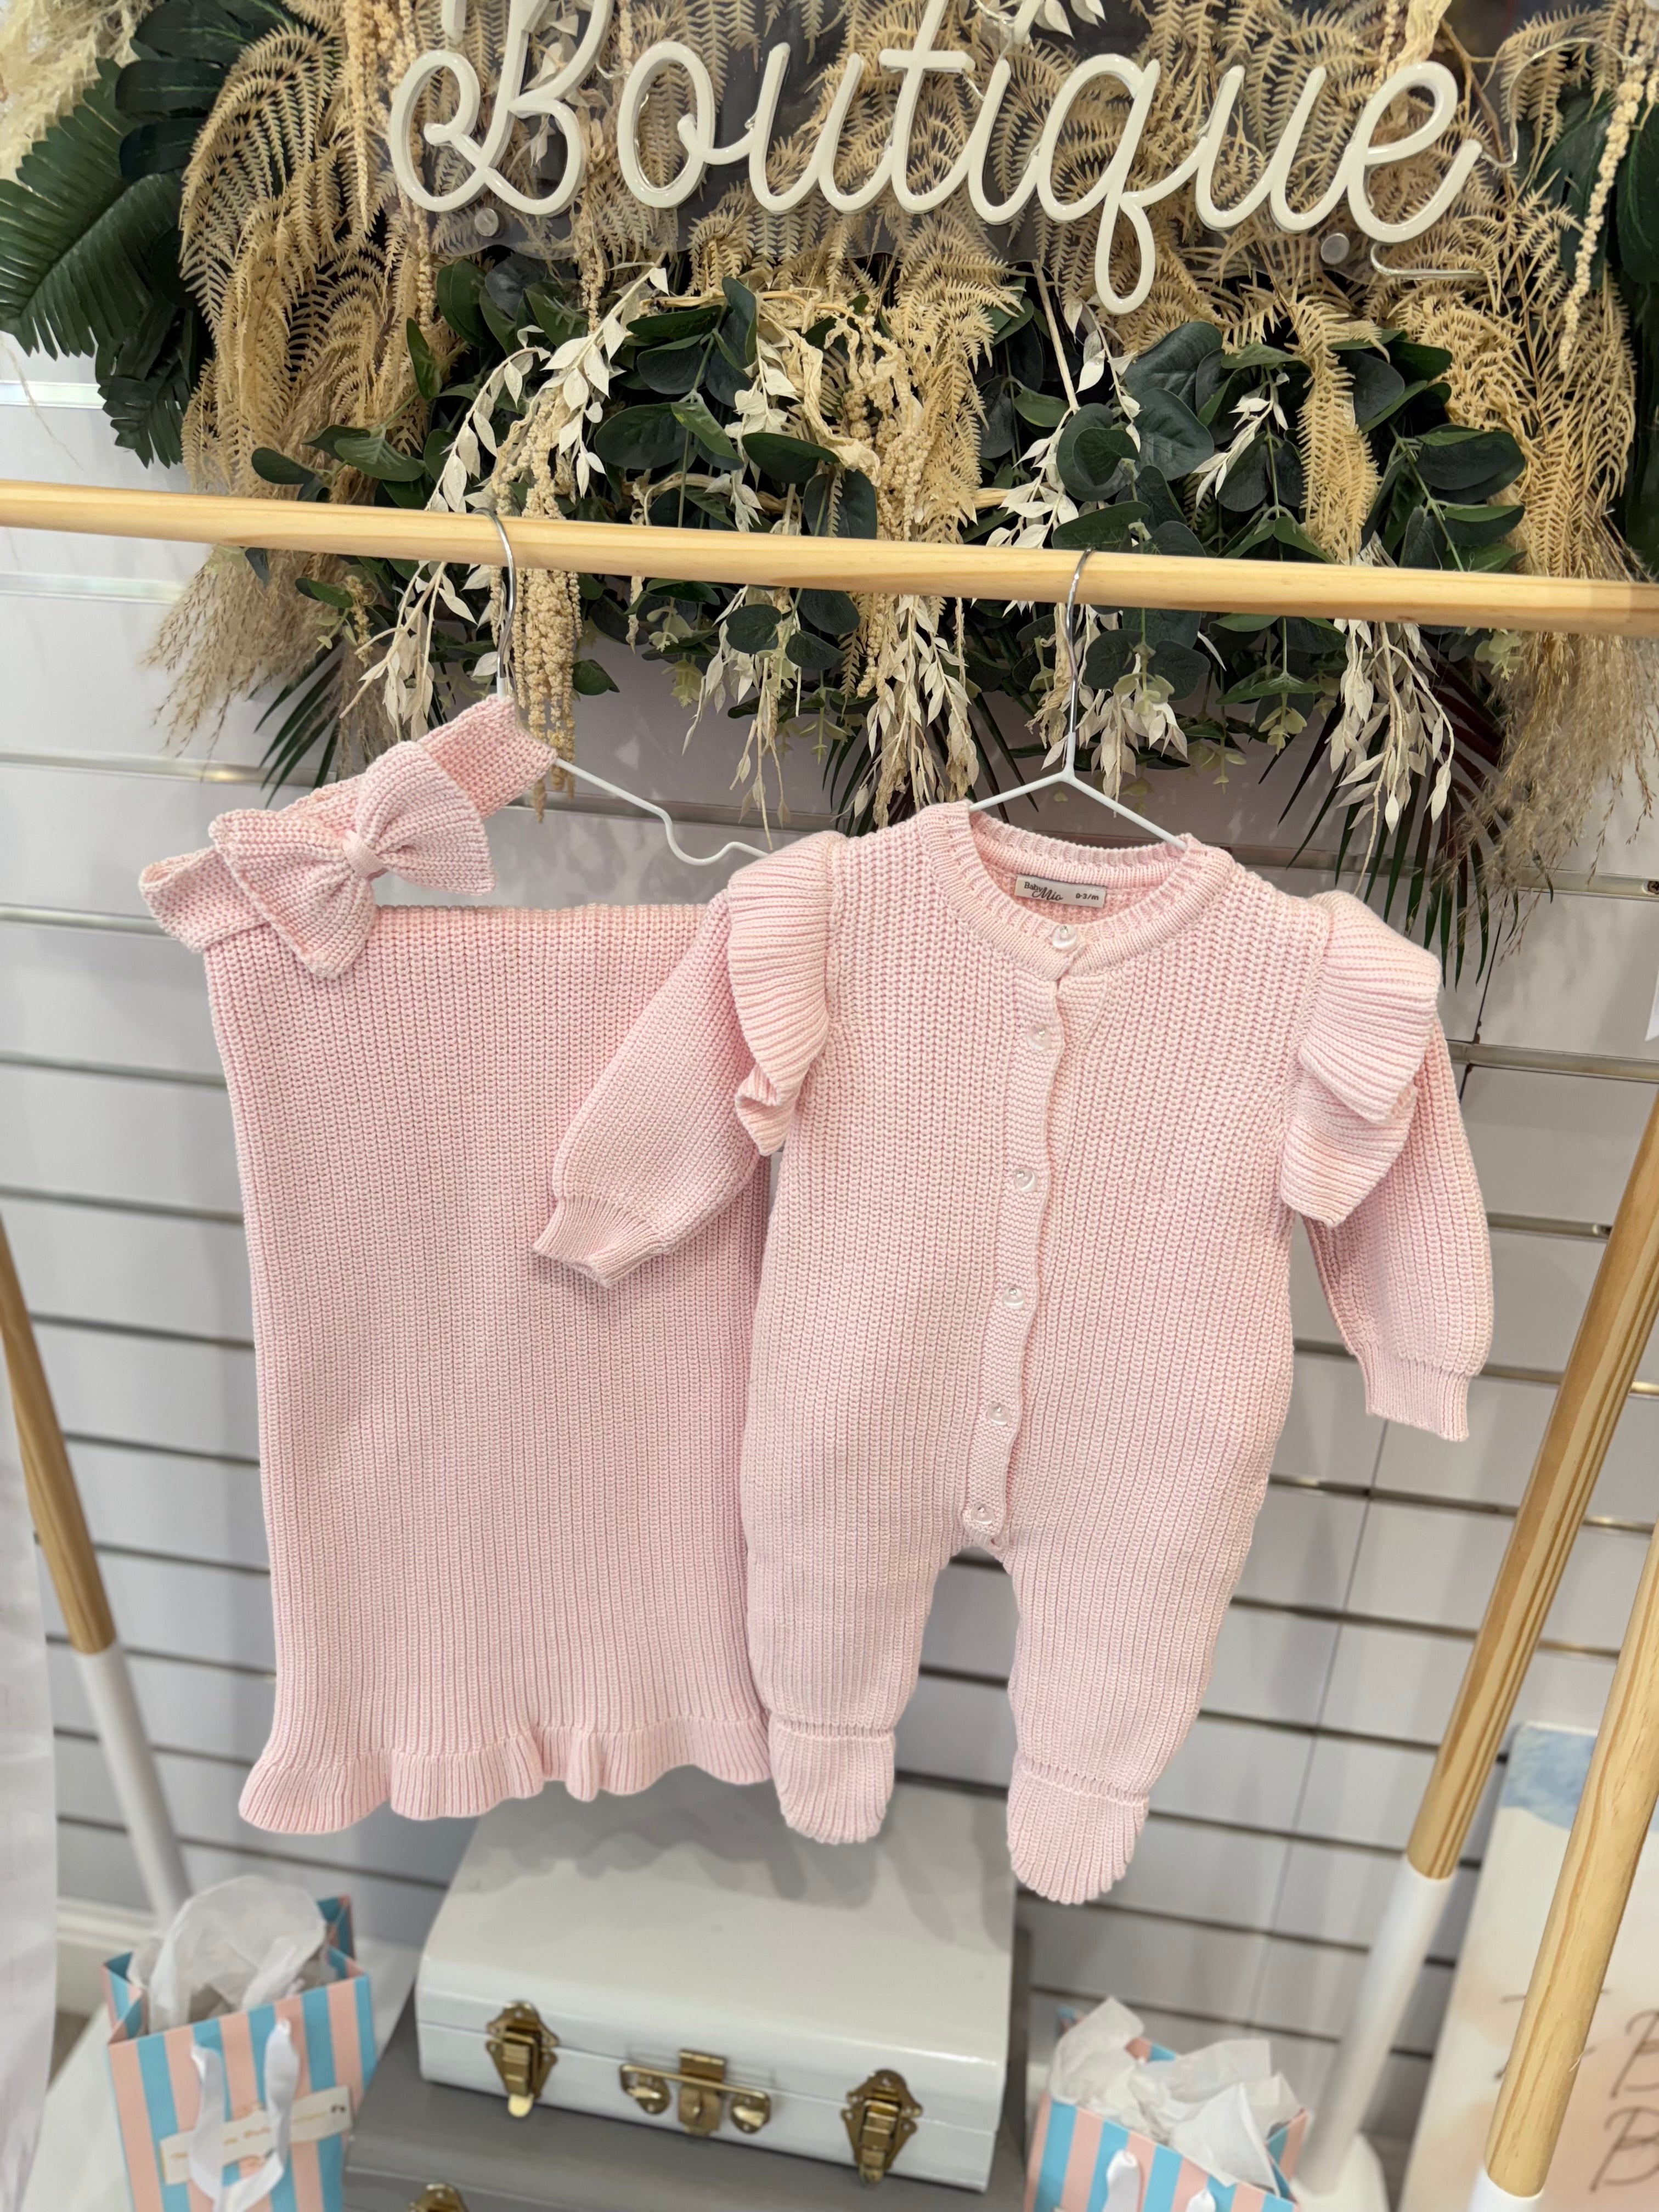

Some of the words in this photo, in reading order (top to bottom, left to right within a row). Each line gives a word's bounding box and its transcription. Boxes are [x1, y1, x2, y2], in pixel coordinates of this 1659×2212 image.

[390, 0, 1482, 315] Boutique
[1024, 882, 1042, 893] Baby
[1031, 887, 1063, 901] Mio
